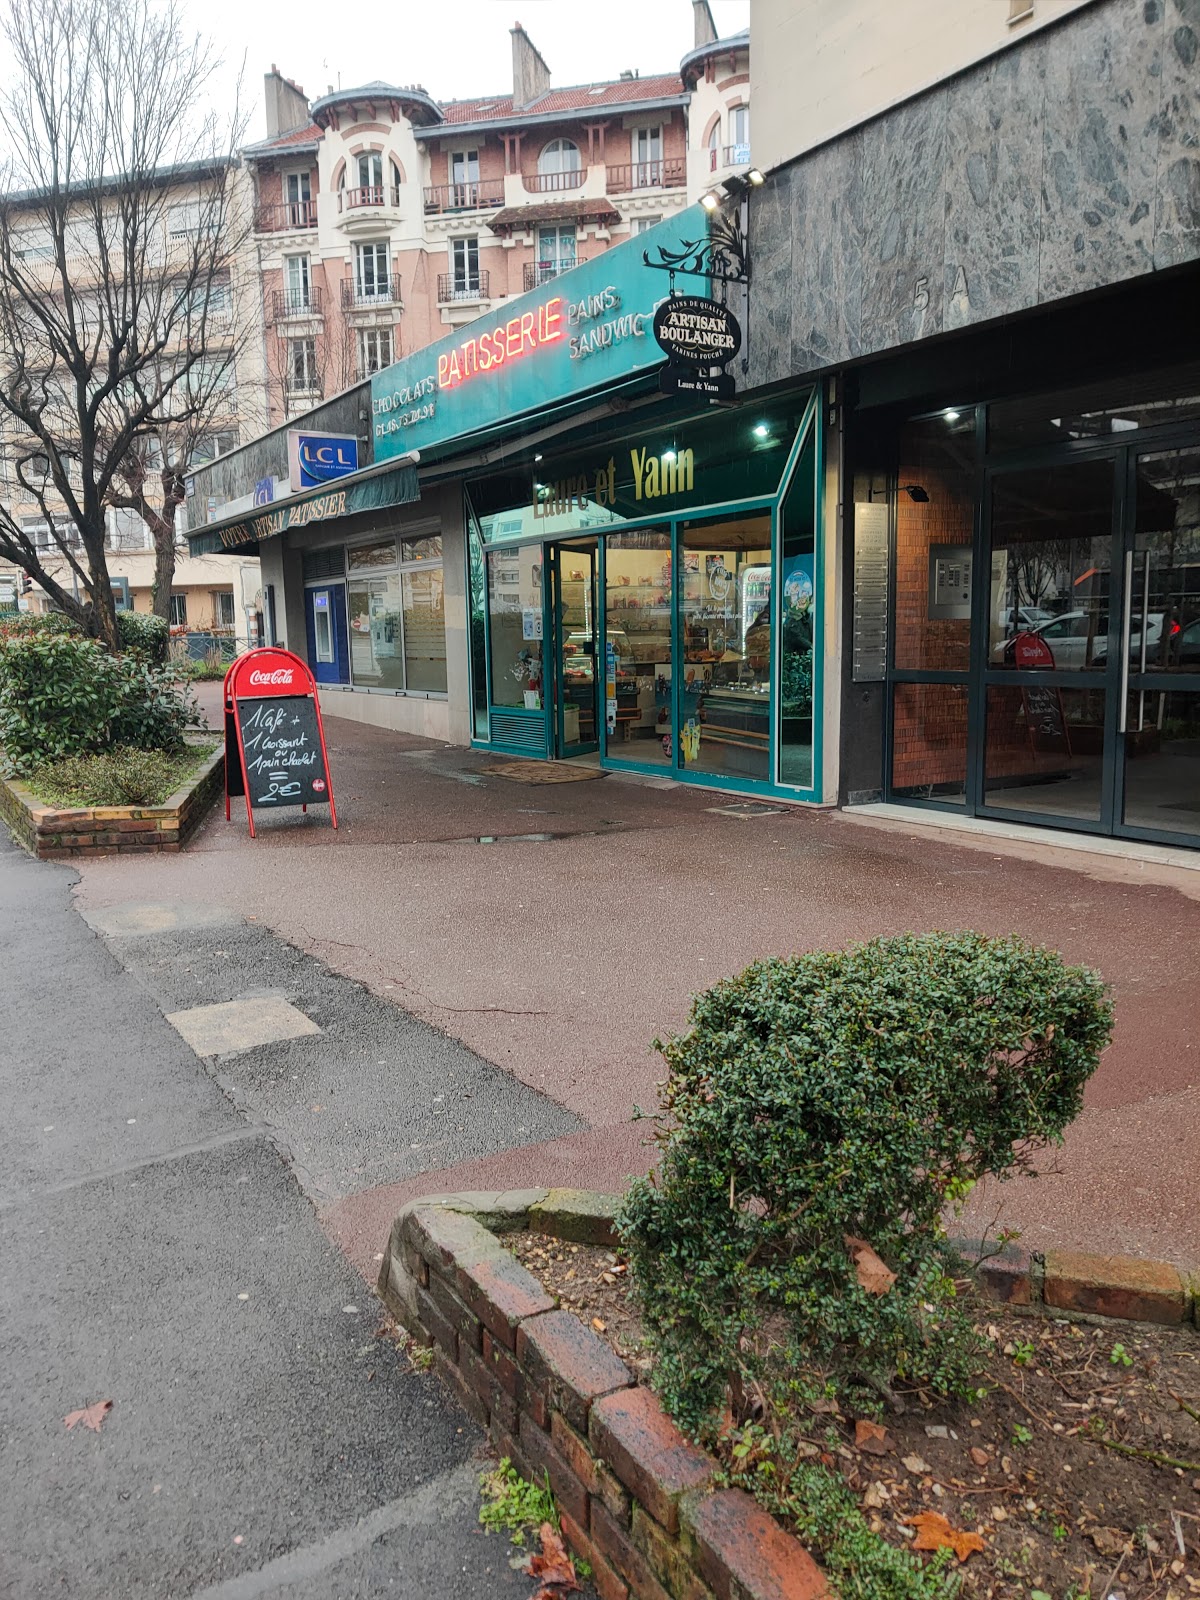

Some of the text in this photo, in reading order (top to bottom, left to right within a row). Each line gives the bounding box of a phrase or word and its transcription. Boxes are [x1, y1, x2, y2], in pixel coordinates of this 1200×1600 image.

[567, 285, 617, 326] PAINS
[668, 300, 687, 311] PAINS
[668, 311, 726, 332] ARTISAN
[438, 297, 561, 388] PATISSERIE
[569, 313, 646, 359] SANDWIC
[659, 325, 735, 349] BOULANGER
[671, 343, 697, 358] FARINES
[371, 375, 435, 415] CHOCOLATS
[677, 379, 719, 392] Laure & Yann
[303, 446, 351, 464] LCL
[532, 446, 694, 519] Laure et Yann
[219, 523, 251, 548] VOTRE
[288, 491, 346, 525] PATISSIER
[249, 668, 294, 685] Coca-Cola
[274, 749, 288, 757] ou
